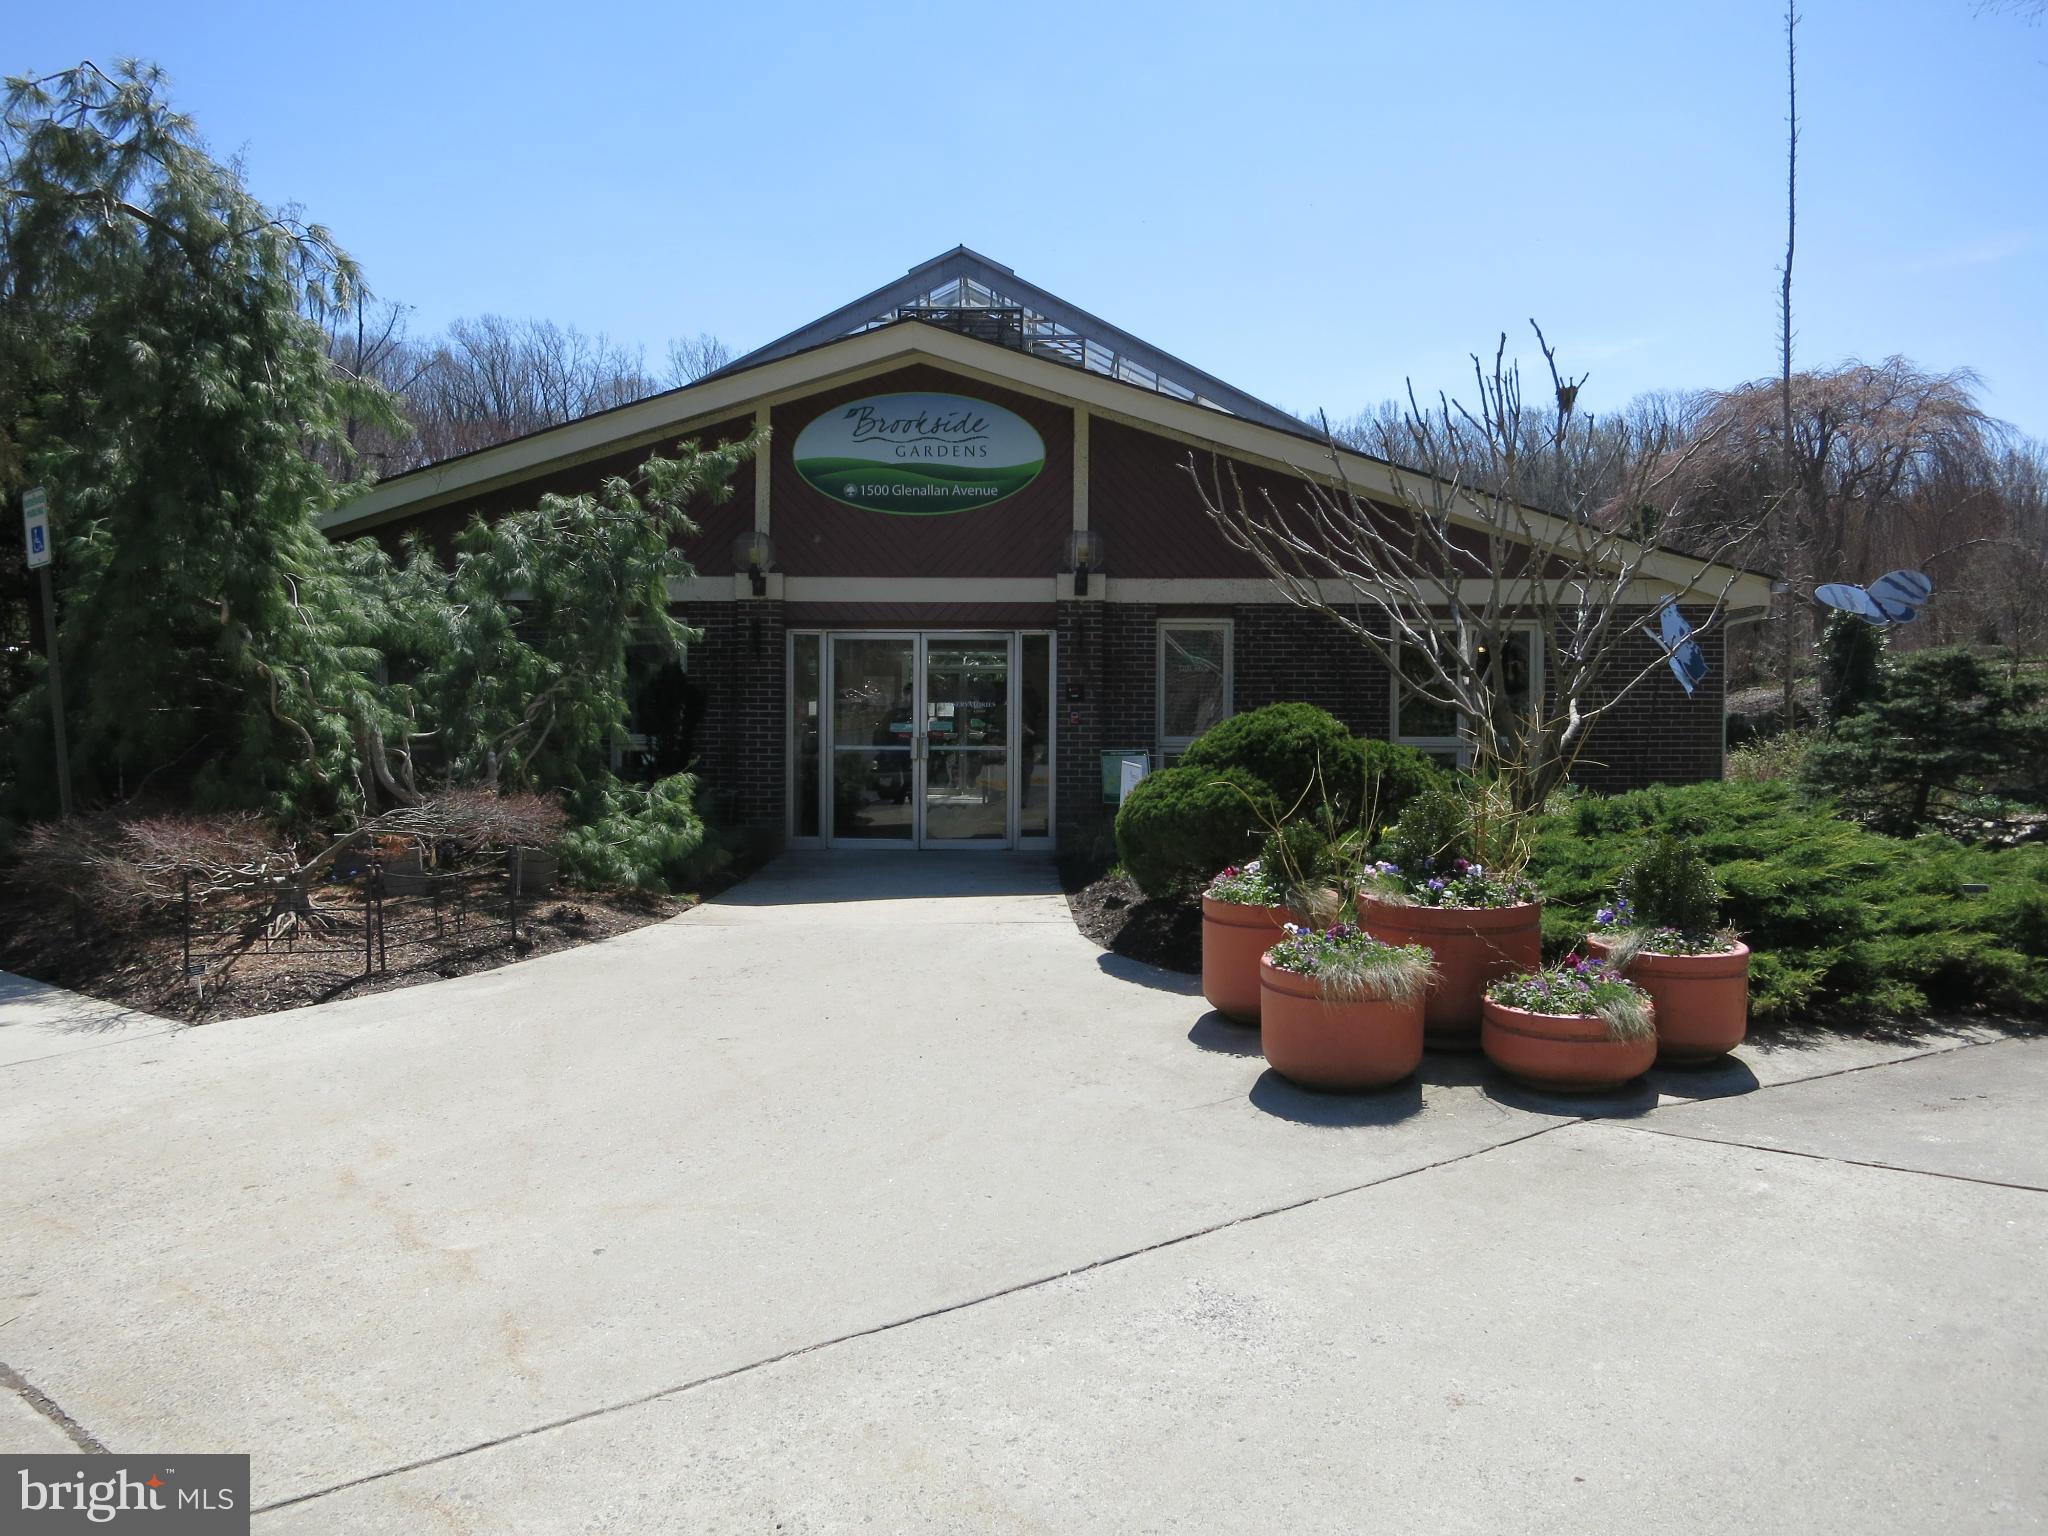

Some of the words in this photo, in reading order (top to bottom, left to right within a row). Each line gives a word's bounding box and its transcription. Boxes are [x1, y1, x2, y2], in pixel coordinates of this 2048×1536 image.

[849, 406, 990, 437] Brookside
[895, 445, 987, 457] GARDENS
[861, 484, 889, 496] 1500
[892, 483, 949, 496] Glenallan
[952, 484, 998, 496] Avenue
